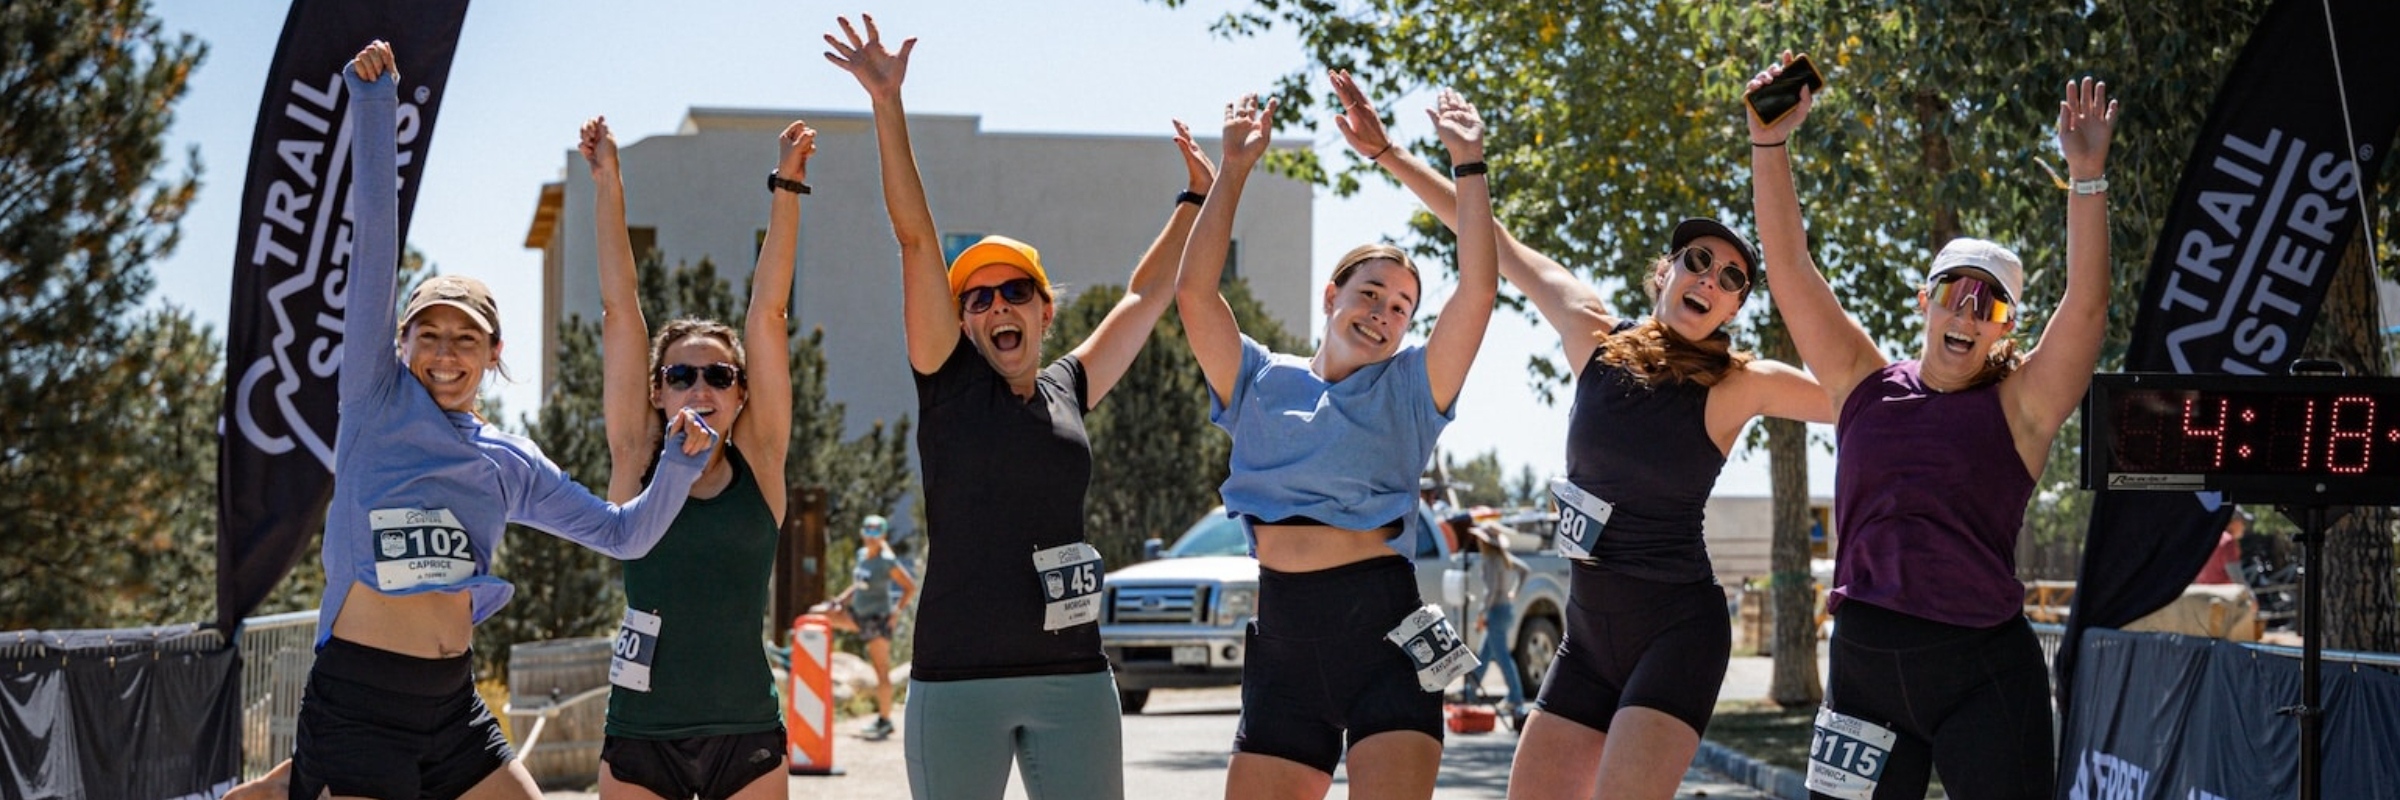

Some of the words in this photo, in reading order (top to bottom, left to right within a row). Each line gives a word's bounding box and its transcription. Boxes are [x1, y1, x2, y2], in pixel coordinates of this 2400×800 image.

[252, 73, 343, 266] TRAIL
[2159, 128, 2282, 311] TRAIL
[2221, 151, 2363, 374] ISTERS
[2183, 395, 2374, 473] 4:18
[408, 528, 471, 559] 102
[1561, 506, 1587, 542] 80
[408, 559, 453, 570] CAPRICE
[1071, 563, 1096, 595] 45
[1823, 734, 1883, 776] 115
